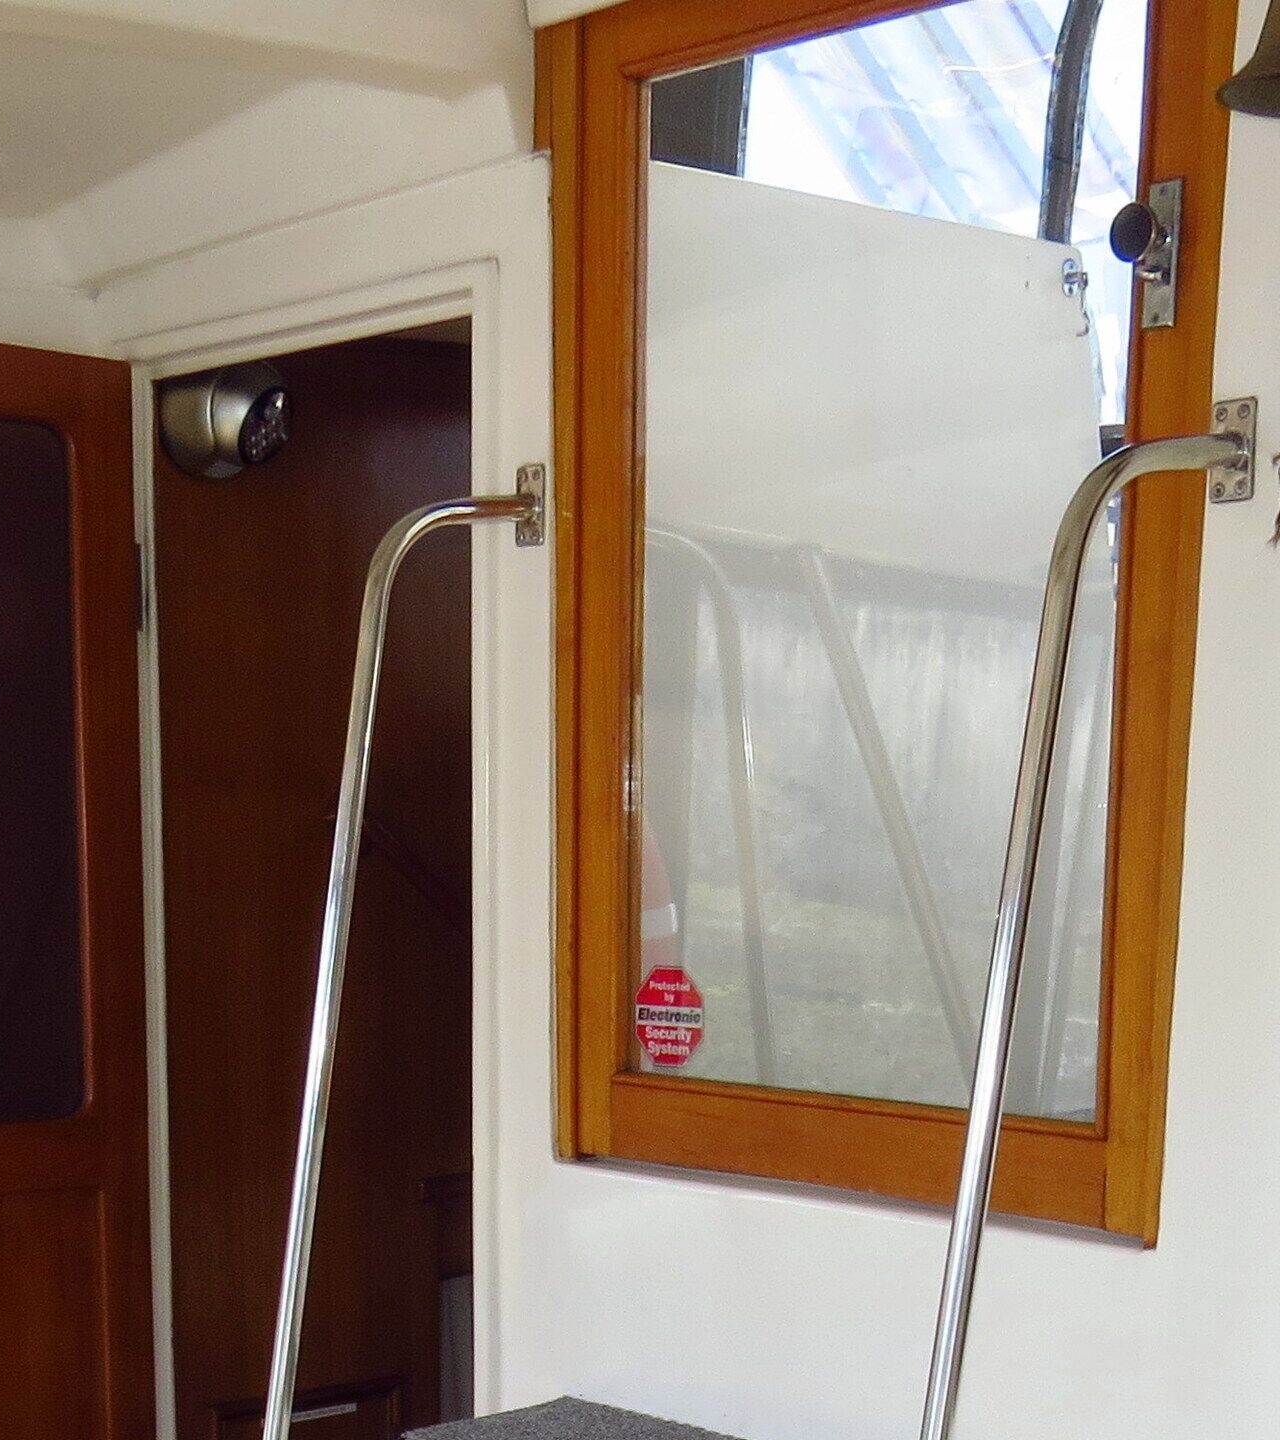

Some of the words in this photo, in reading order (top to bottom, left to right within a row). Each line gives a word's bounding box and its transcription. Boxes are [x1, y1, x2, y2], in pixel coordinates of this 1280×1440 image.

[648, 980, 691, 992] Protected
[663, 992, 675, 1004] by
[637, 1007, 701, 1023] Electronic
[644, 1026, 692, 1043] Security
[647, 1040, 691, 1056] System
